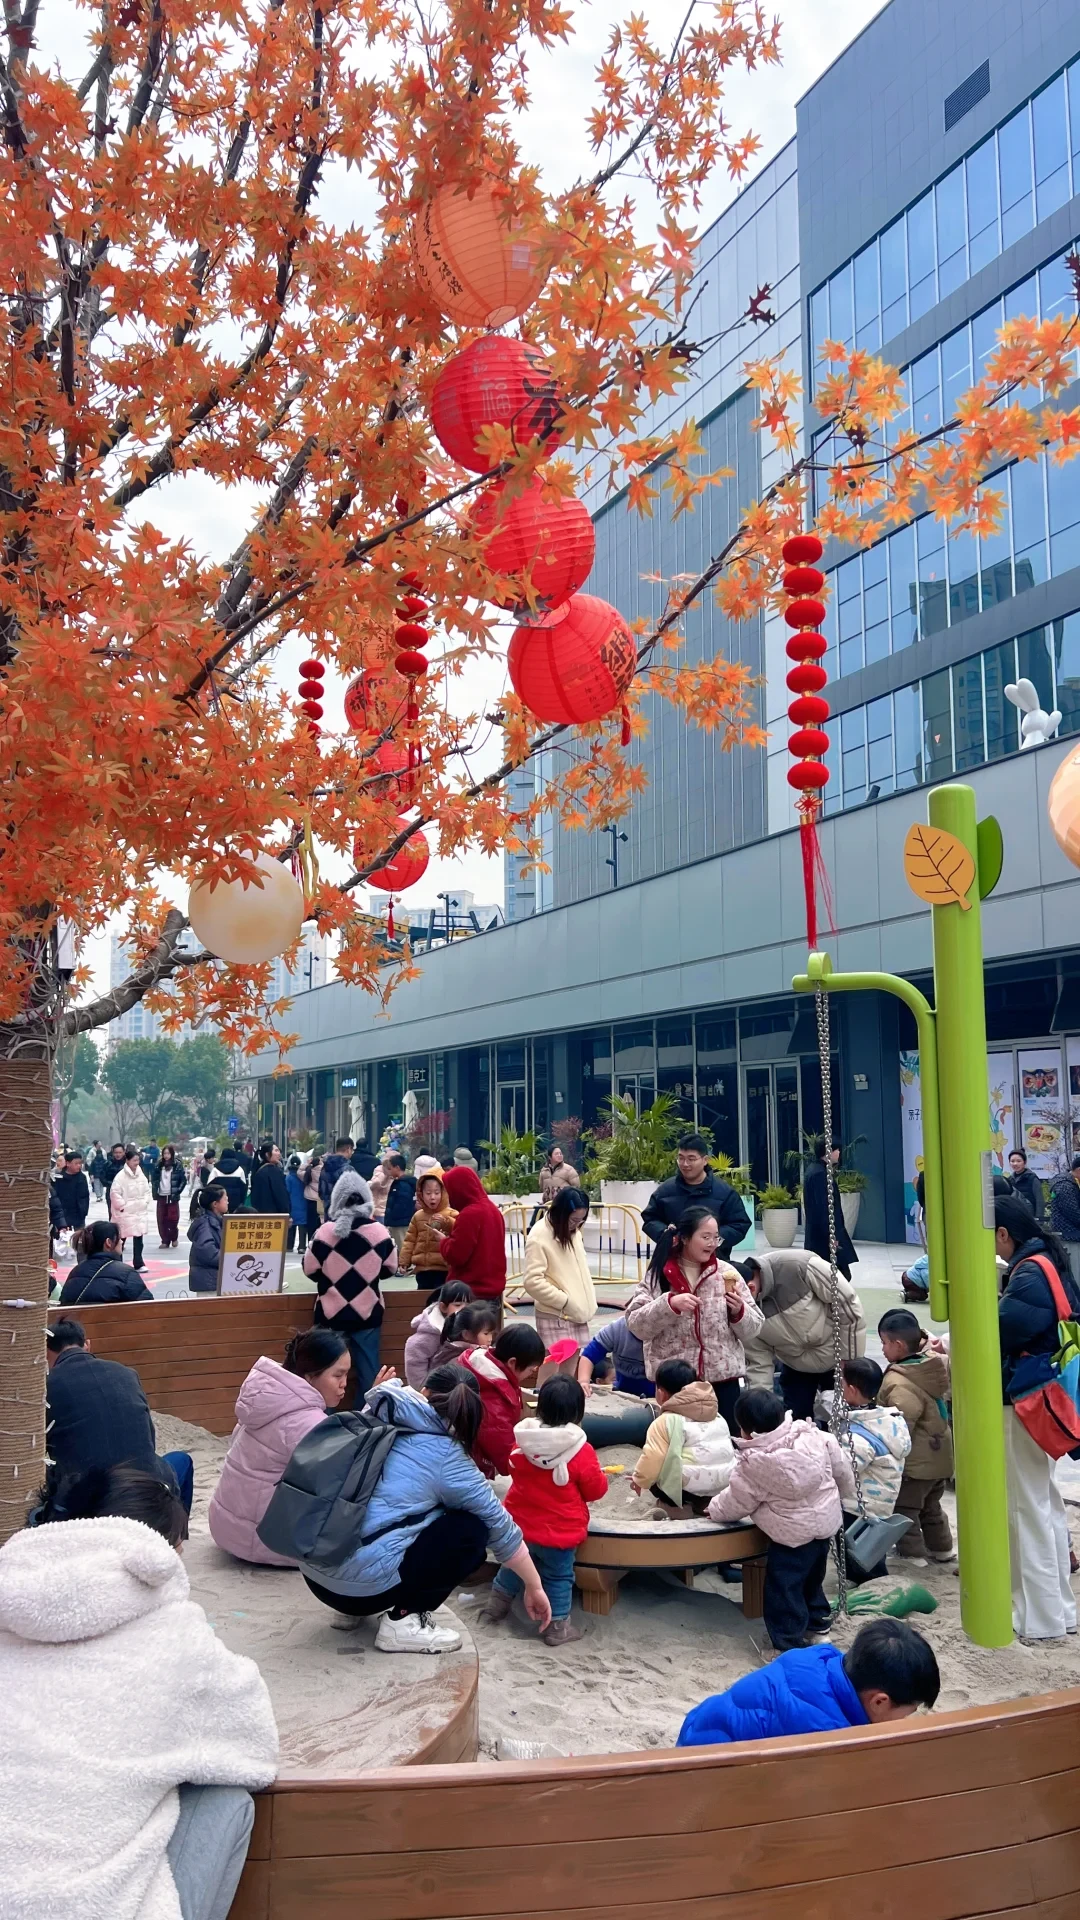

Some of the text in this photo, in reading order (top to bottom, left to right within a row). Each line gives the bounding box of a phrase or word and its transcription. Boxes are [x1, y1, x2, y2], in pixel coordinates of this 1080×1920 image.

[908, 1108, 922, 1121] 亲子
[229, 1221, 282, 1230] 玩耍时请注意
[237, 1231, 273, 1240] 脚下细沙
[236, 1241, 272, 1250] 防止打滑
